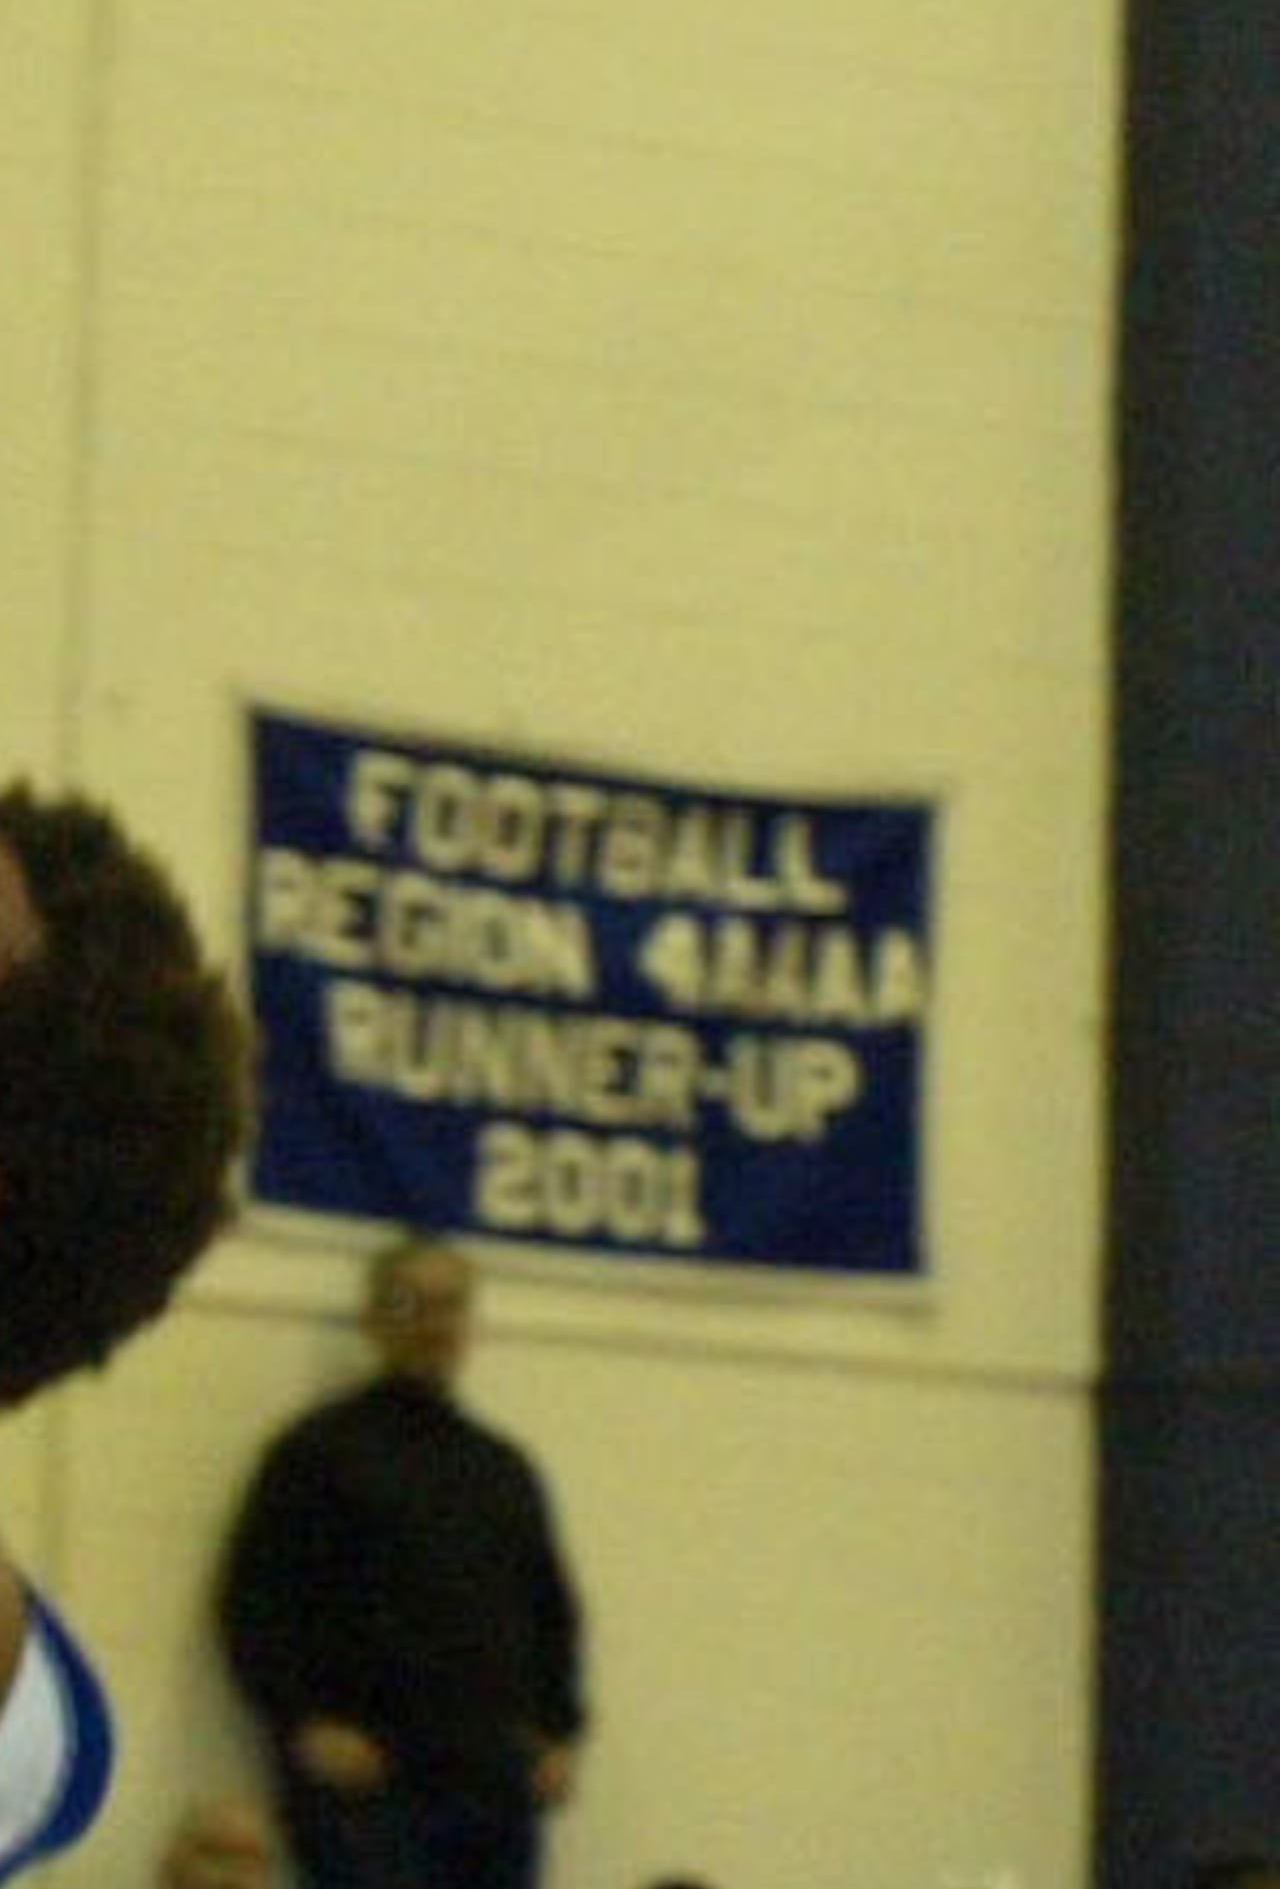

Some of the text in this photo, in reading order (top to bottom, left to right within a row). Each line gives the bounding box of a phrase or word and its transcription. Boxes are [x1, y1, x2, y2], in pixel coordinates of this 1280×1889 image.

[347, 748, 846, 908] FOOTBALL
[258, 847, 598, 1002] REGION
[326, 978, 862, 1142] RUNNER-UP
[472, 1120, 706, 1247] 2001
